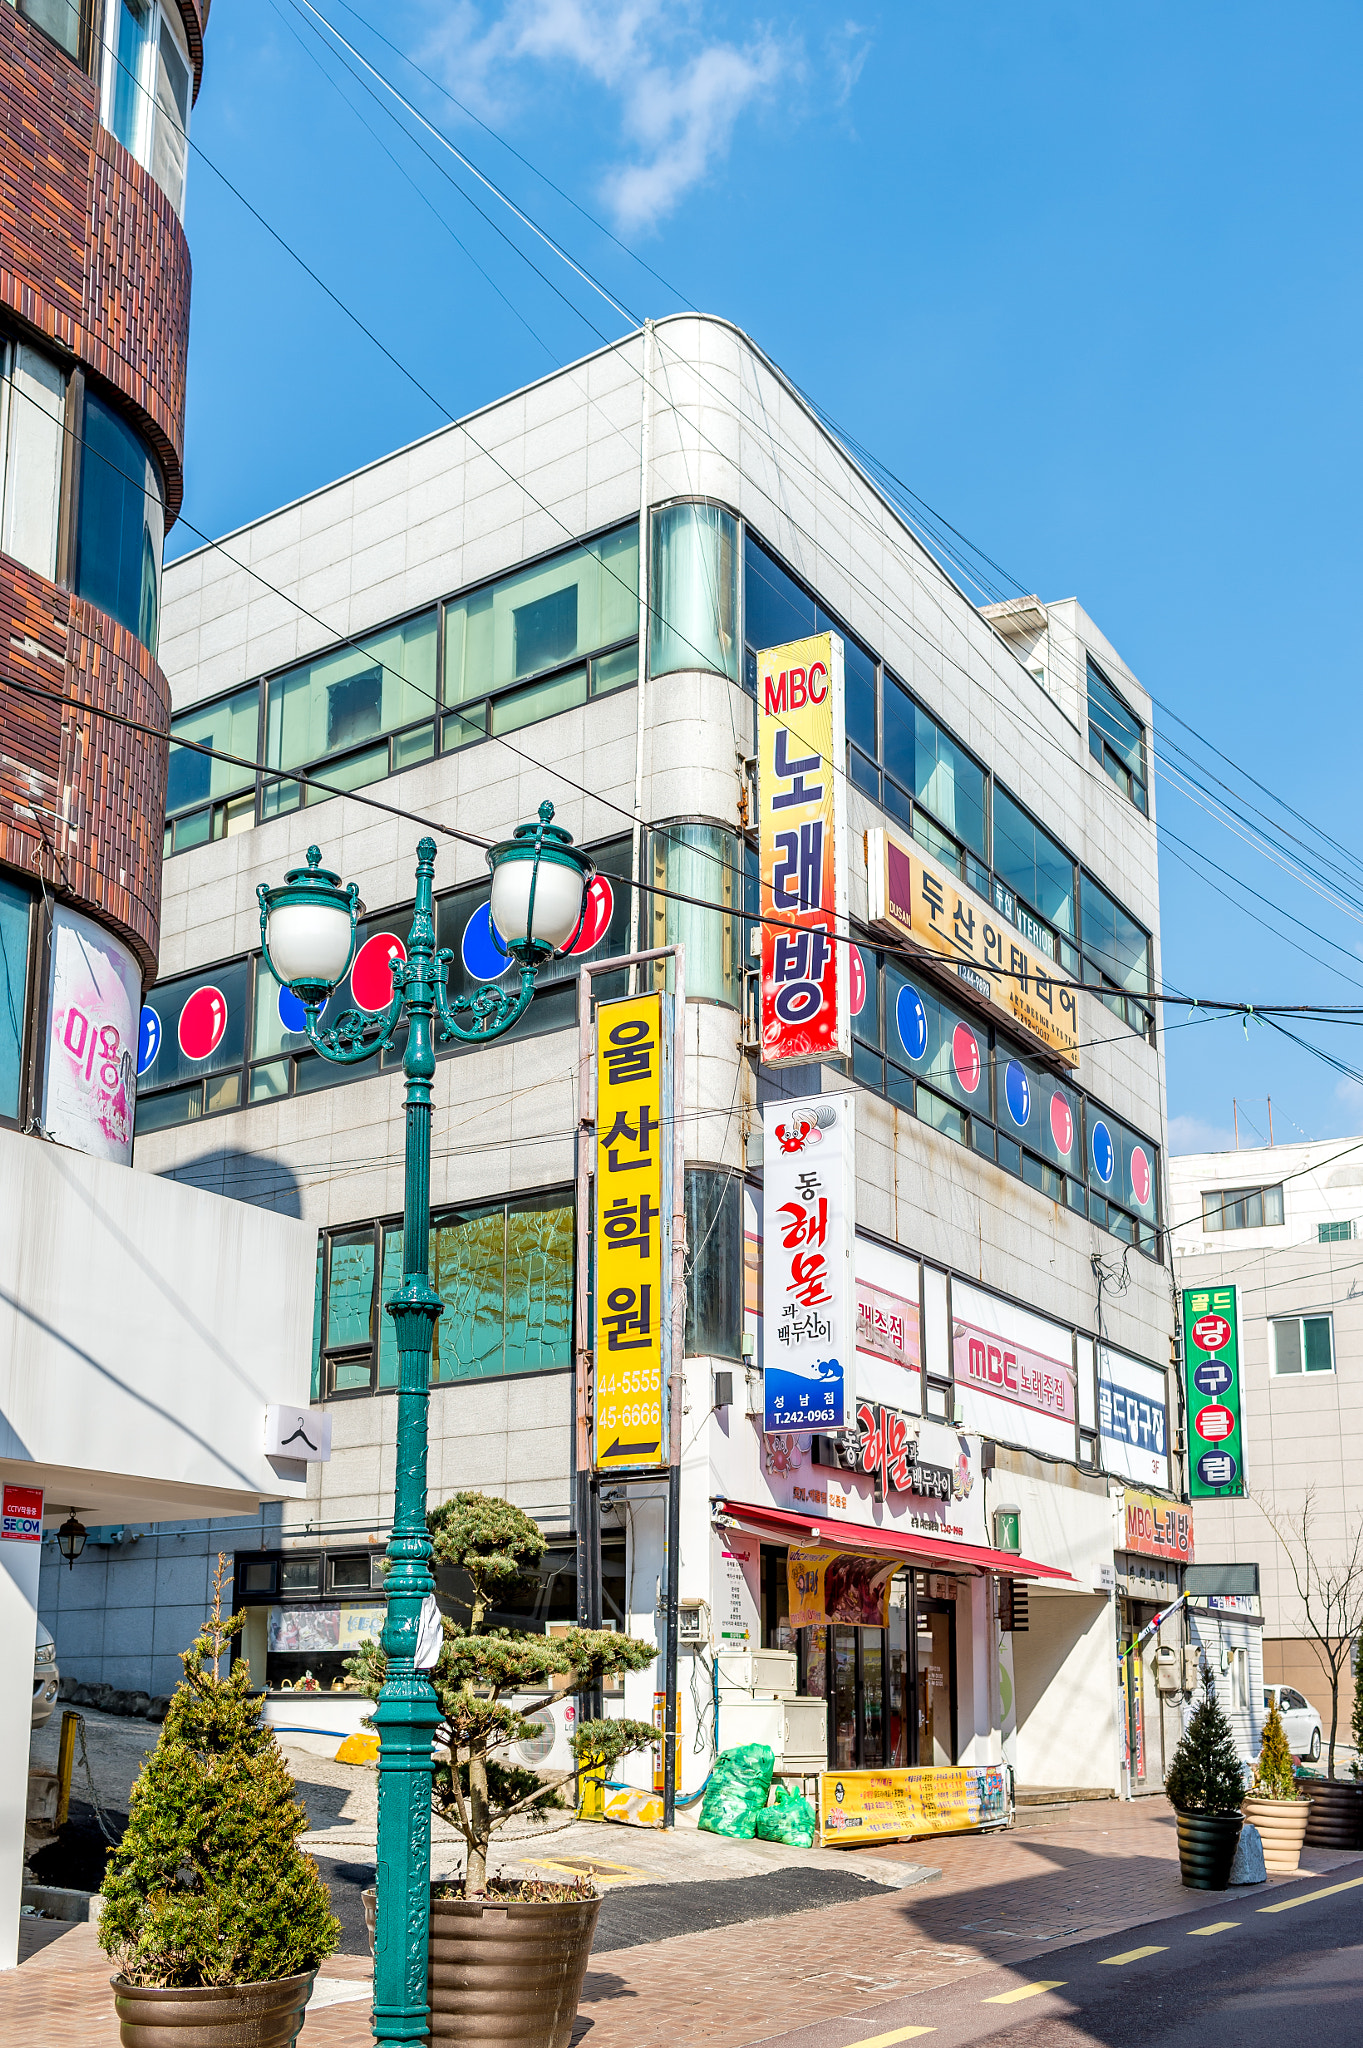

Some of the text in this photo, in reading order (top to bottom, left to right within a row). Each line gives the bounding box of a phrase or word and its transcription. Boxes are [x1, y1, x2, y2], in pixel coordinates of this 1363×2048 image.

[765, 662, 827, 716] MBC
[771, 728, 830, 1023] 노래방
[889, 899, 911, 928] DUSAN
[996, 883, 1053, 961] 두산 NTERIOR
[922, 870, 1077, 1033] 두산인테리어
[64, 1007, 121, 1092] 미용
[601, 1021, 660, 1352] 울산학원
[1192, 1292, 1231, 1311] 골드
[777, 1311, 832, 1347] 백두산이
[968, 1336, 1065, 1409] MBC 노래주점
[598, 1401, 660, 1430] 45-6666
[774, 1409, 836, 1425] T.242-0963
[1099, 1386, 1165, 1453] 골드당구장
[1195, 1319, 1231, 1482] 당구클럽
[912, 1466, 951, 1500] 백두산이
[1151, 1459, 1160, 1475] 3F
[3, 1518, 40, 1533] SECOM
[1127, 1505, 1189, 1550] MBC 노래방
[564, 1723, 575, 1731] LG
